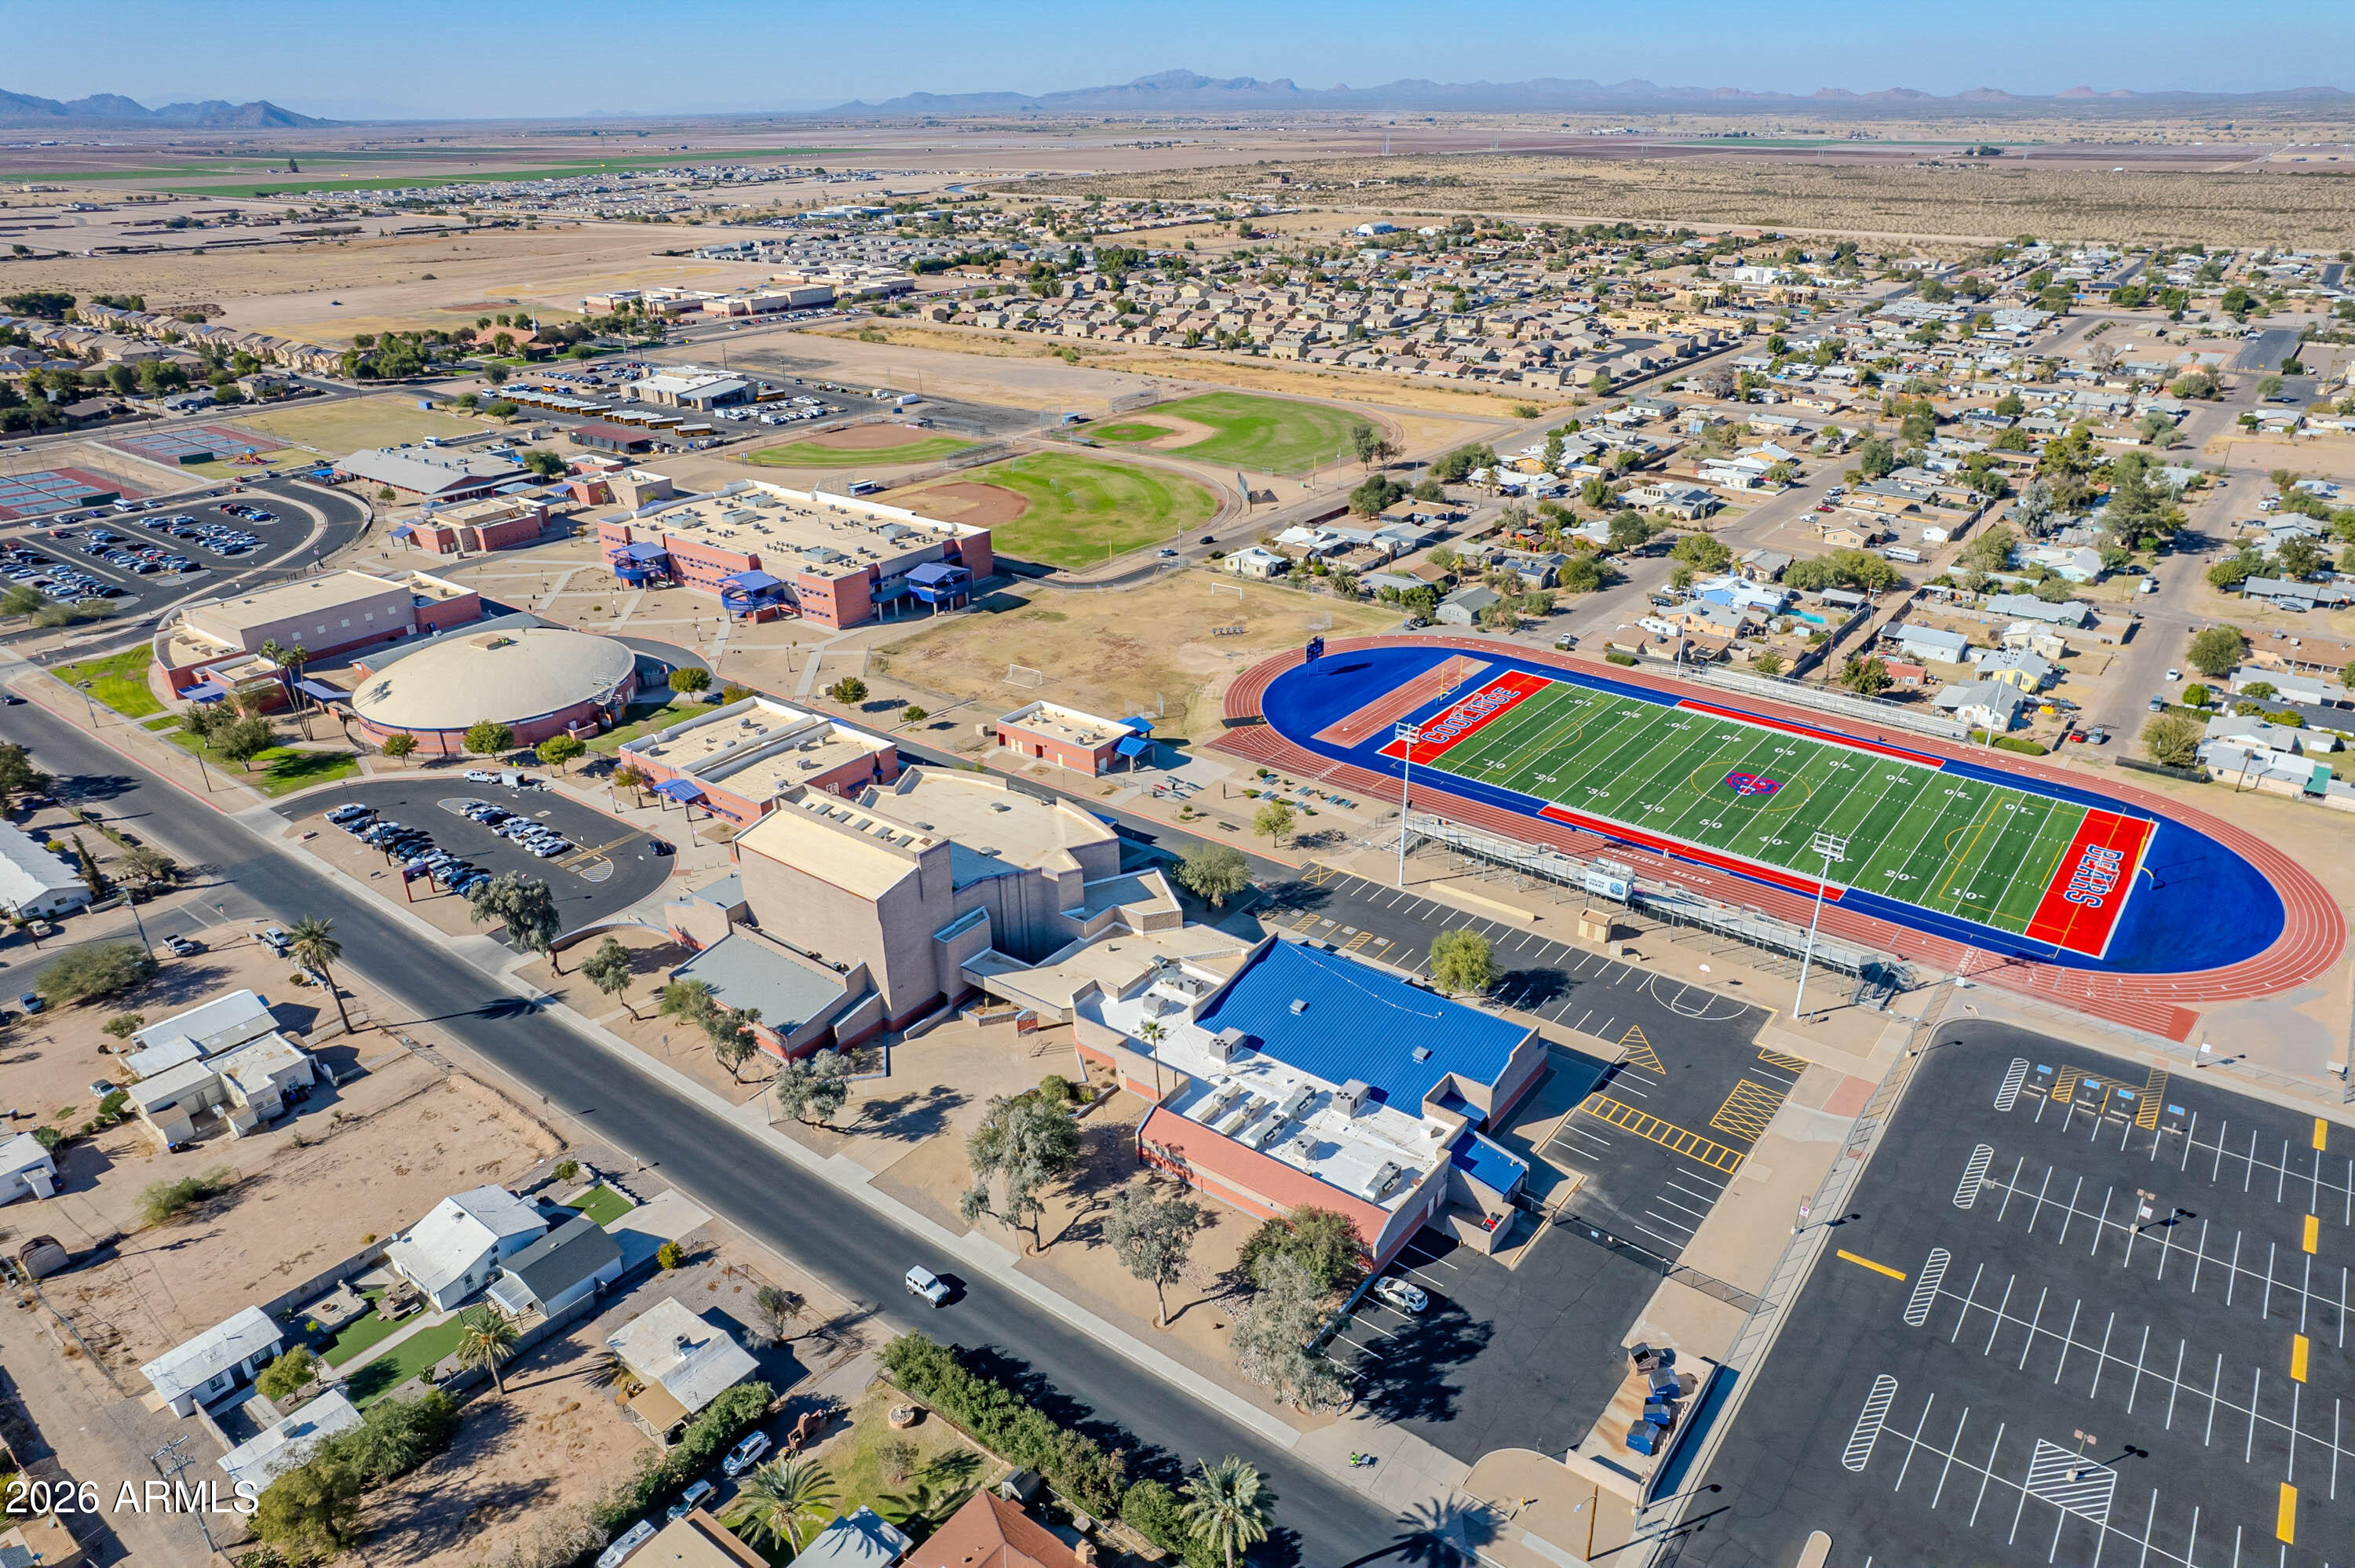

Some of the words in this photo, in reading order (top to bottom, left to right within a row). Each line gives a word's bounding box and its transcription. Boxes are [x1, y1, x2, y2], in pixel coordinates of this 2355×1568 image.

[1420, 687, 1521, 744] COOLIDGE
[1484, 759, 1506, 769] 10
[1535, 773, 1557, 783] 20
[1587, 788, 1610, 798] 30
[1641, 804, 1665, 813] 40
[1699, 819, 1722, 829] 50
[1758, 836, 1783, 845] 40
[1672, 870, 1714, 885] BEARS
[1884, 870, 1910, 881] 20
[2063, 844, 2125, 908] BEARS
[1951, 887, 1977, 899] 10
